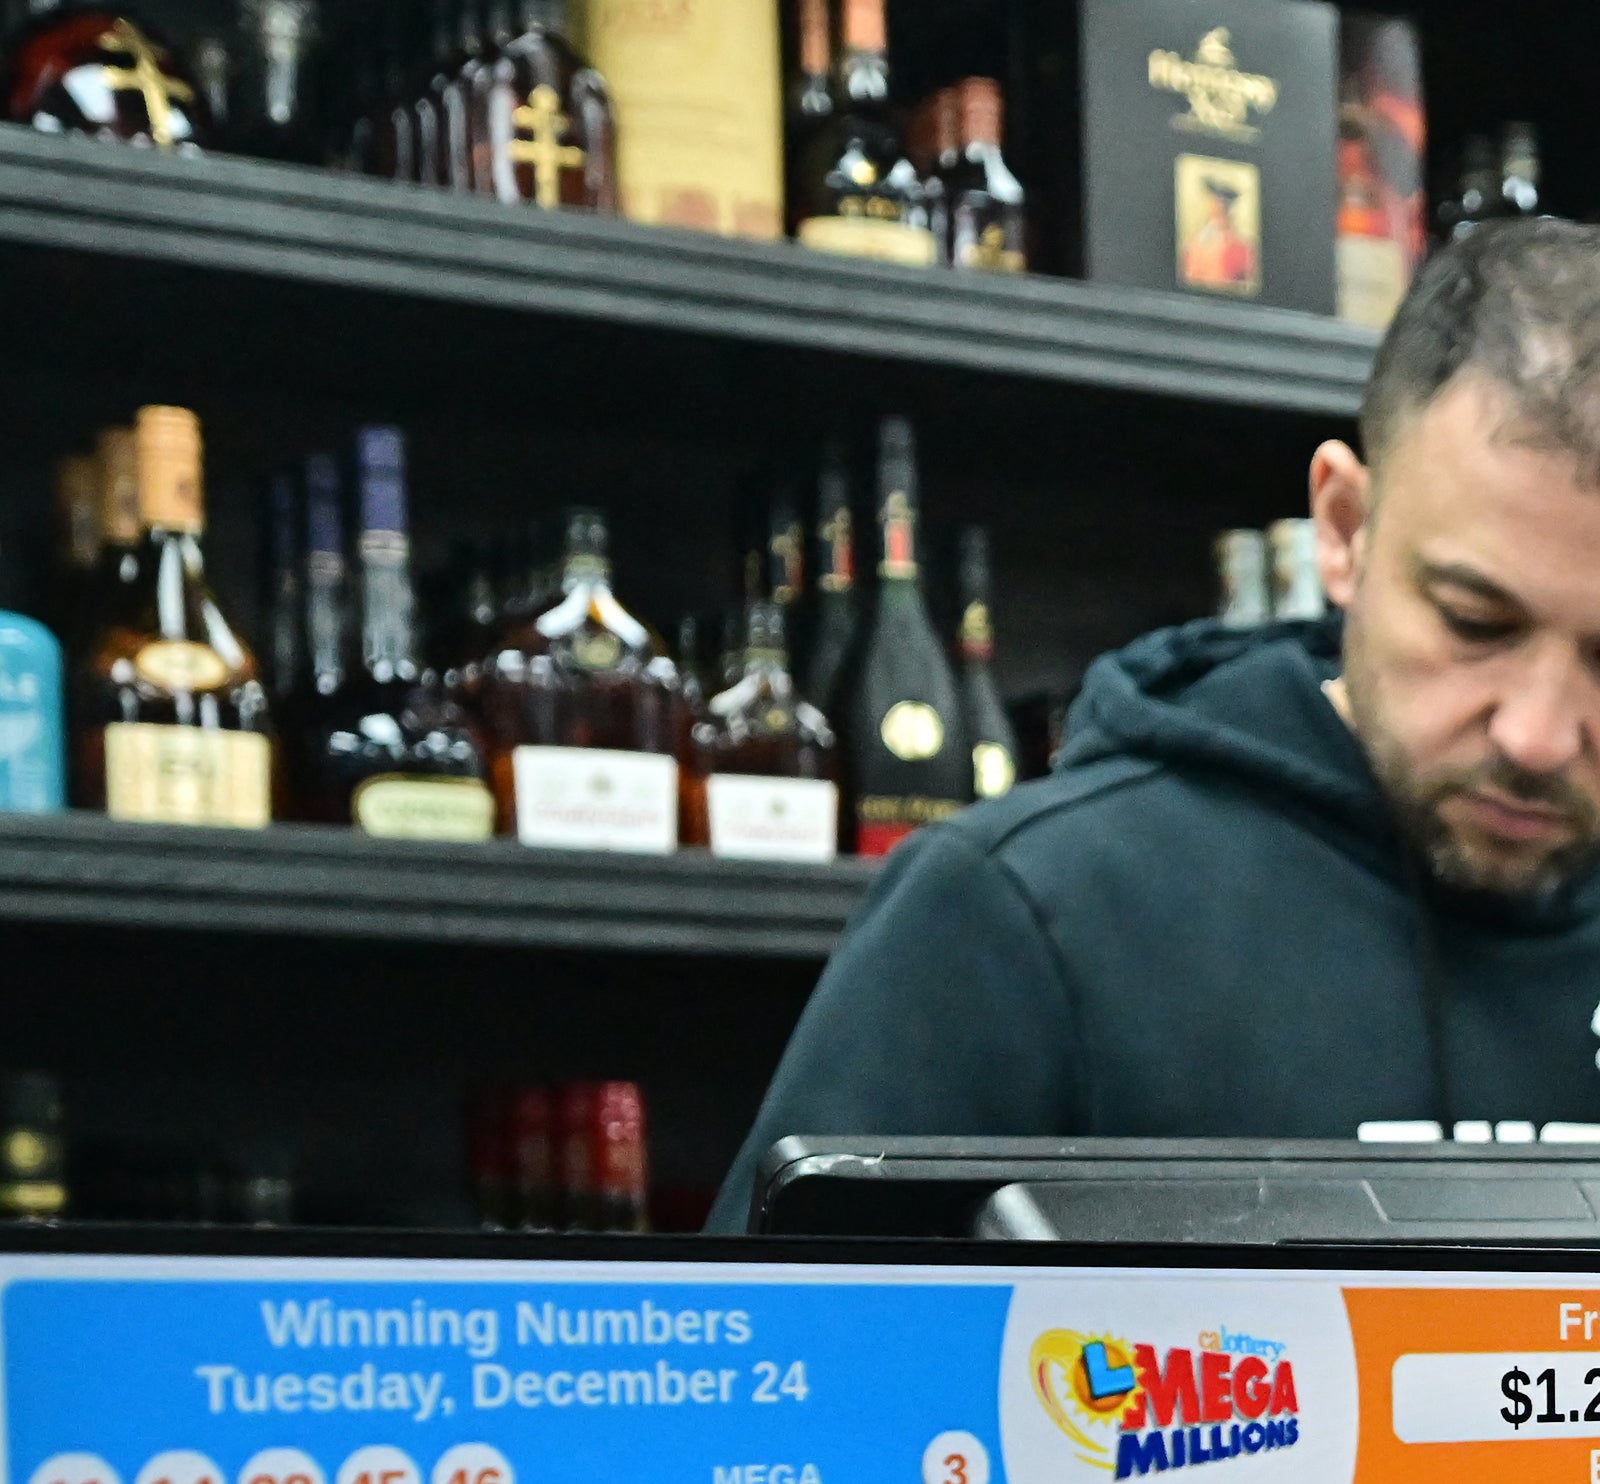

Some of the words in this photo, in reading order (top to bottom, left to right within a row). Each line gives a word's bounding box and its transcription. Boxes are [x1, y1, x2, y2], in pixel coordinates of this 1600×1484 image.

[262, 1299, 499, 1359] Winning
[517, 1299, 752, 1347] Numbers
[199, 1363, 455, 1421] Tuesday,
[474, 1363, 735, 1409] December
[751, 1361, 808, 1404] 24
[1120, 1344, 1298, 1430] MEGA
[1115, 1419, 1299, 1481] MILLIONS
